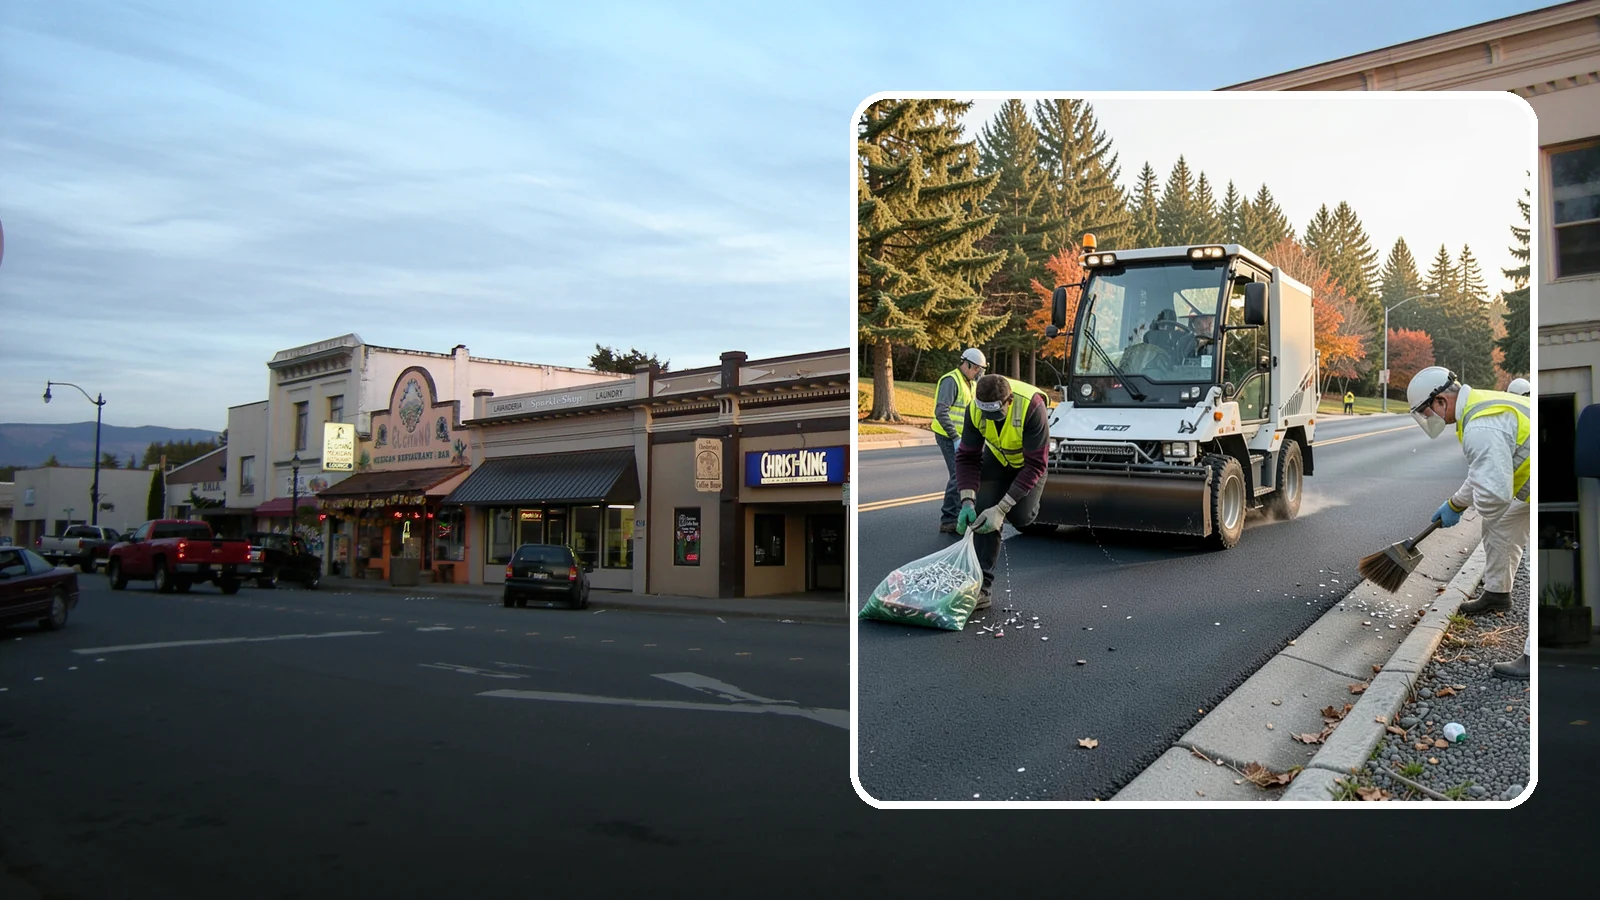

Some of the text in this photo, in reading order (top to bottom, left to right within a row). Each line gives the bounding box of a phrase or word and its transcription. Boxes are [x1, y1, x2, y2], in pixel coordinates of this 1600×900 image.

[530, 394, 582, 408] Sparkle Shop
[595, 389, 624, 400] LAUNDRY
[493, 402, 523, 412] LAVANDERIA
[373, 450, 450, 464] MEXICAN RESTAURANT BAR
[760, 450, 827, 478] CHRIST KING
